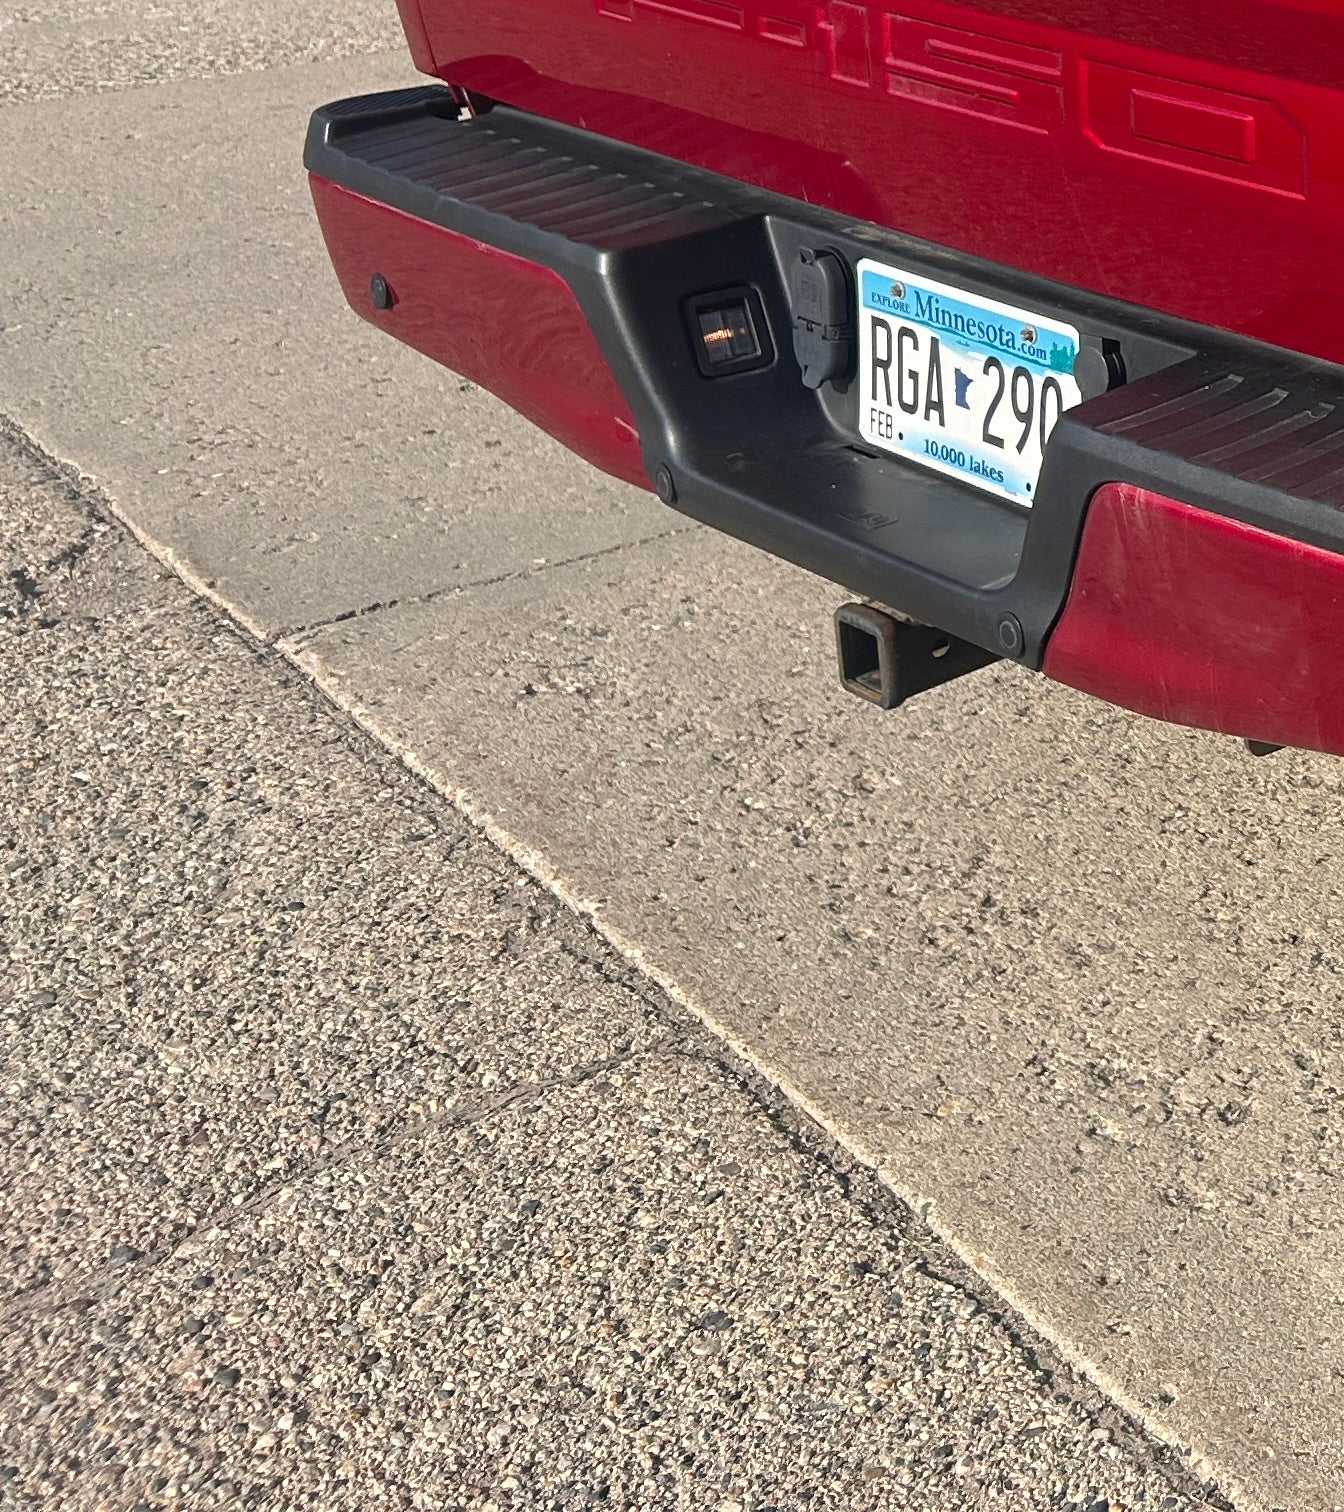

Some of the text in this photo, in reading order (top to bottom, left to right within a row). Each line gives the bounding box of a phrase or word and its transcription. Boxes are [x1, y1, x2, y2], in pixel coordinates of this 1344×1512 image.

[871, 291, 911, 315] EXPLORE
[871, 314, 1064, 458] RGA 290
[870, 407, 893, 440] FEB
[923, 438, 1005, 483] 10,000 lakes
